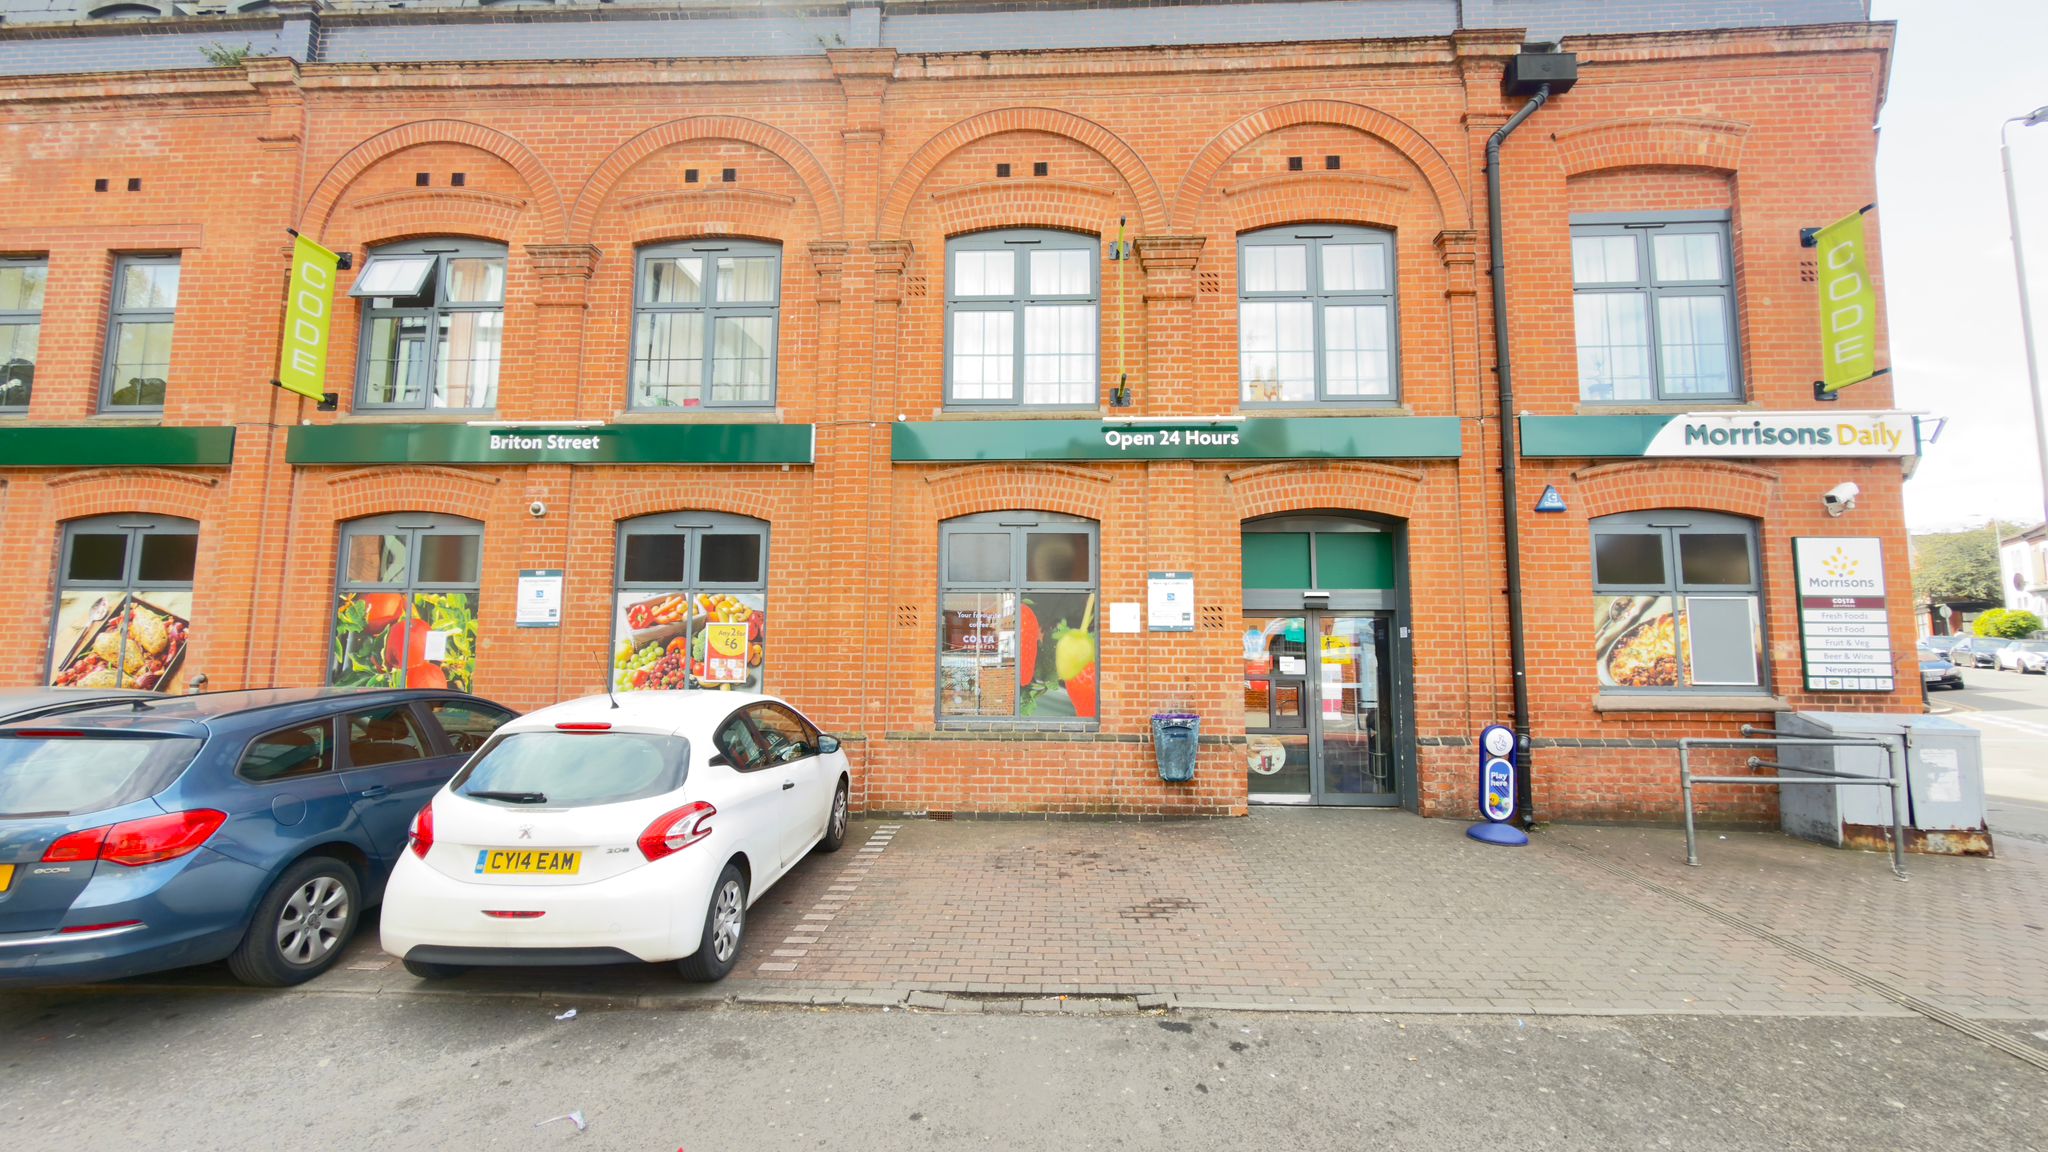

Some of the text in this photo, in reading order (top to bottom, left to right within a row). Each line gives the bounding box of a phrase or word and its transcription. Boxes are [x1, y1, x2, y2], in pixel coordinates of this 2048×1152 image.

[1828, 240, 1864, 364] CODE
[292, 261, 327, 377] CODE
[1105, 430, 1240, 450] Open 24 Hours
[1684, 421, 1902, 452] Morrisons Daily
[490, 434, 601, 450] Briton Street
[1809, 573, 1875, 588] Morrisons
[957, 611, 972, 619] Your
[1821, 612, 1869, 620] Fresh Foods
[731, 627, 737, 636] 2
[725, 638, 738, 650] £6
[962, 635, 996, 644] COTA
[1825, 639, 1844, 647] Fruit
[1854, 640, 1870, 648] Veg
[1824, 652, 1842, 660] Beer
[1825, 666, 1874, 674] Newspapers
[1490, 772, 1507, 781] Play
[491, 852, 575, 871] CY14 EAM
